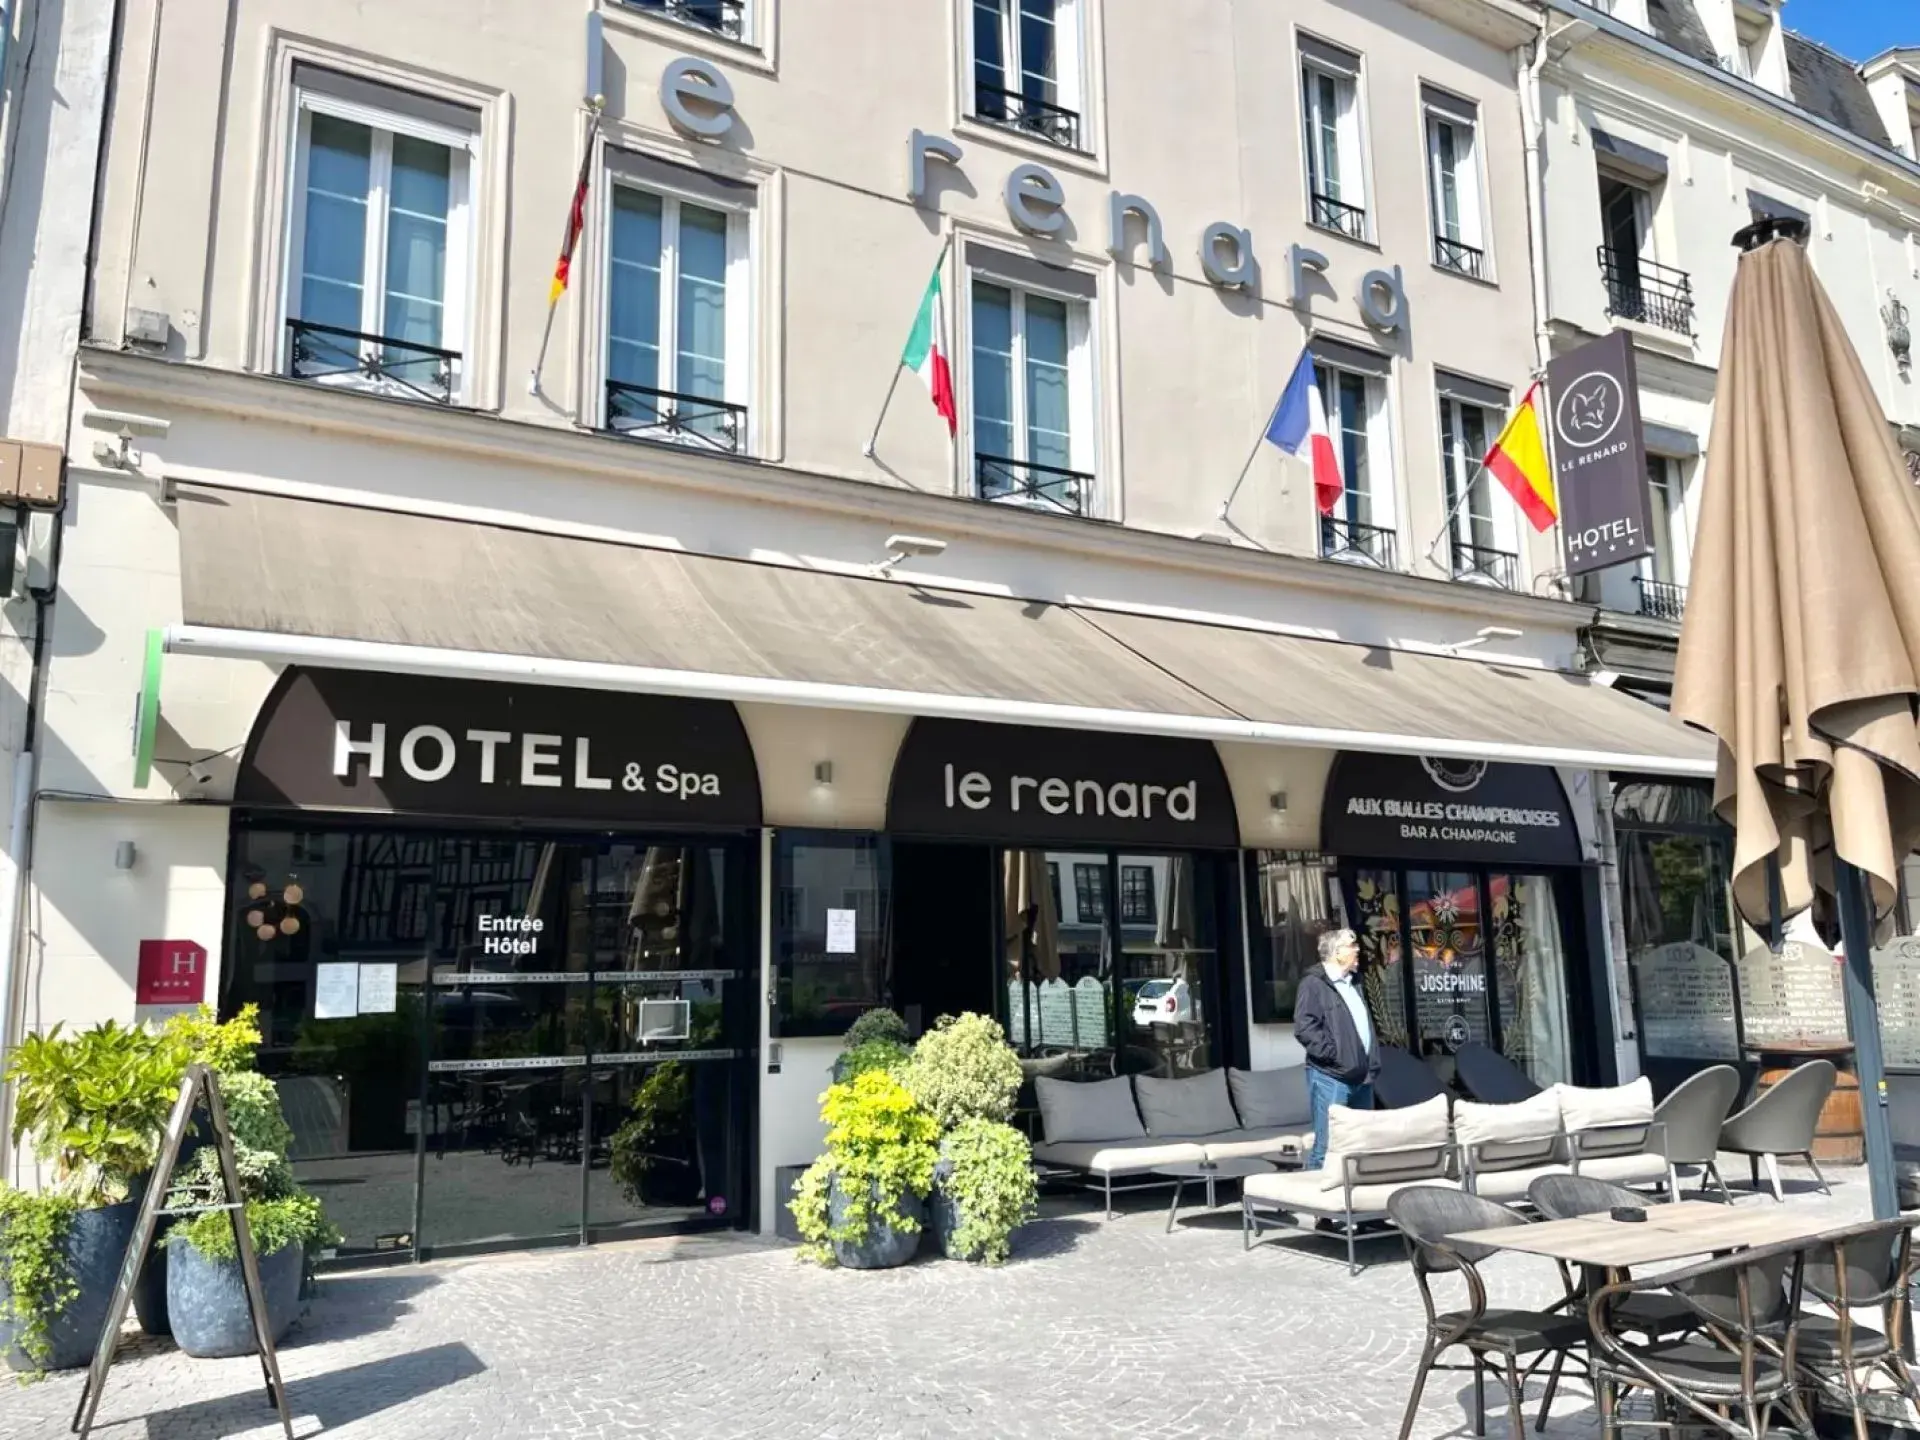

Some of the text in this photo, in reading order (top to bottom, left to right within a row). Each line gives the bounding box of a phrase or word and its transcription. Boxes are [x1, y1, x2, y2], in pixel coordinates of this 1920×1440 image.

[586, 10, 1408, 331] le renard
[1561, 442, 1628, 472] LE RENARD
[1567, 517, 1639, 553] HOTEL
[333, 719, 721, 800] HOTEL & Spa
[944, 763, 1197, 821] le renard
[1347, 797, 1561, 827] AUX BULLES CHAMPENOISES
[1401, 824, 1427, 839] BAR
[1441, 828, 1518, 845] CHAMPAGNE
[478, 914, 544, 932] Entrée
[484, 937, 537, 954] Hôtel
[171, 951, 199, 975] H
[1419, 972, 1486, 992] JOSÉPHINE
